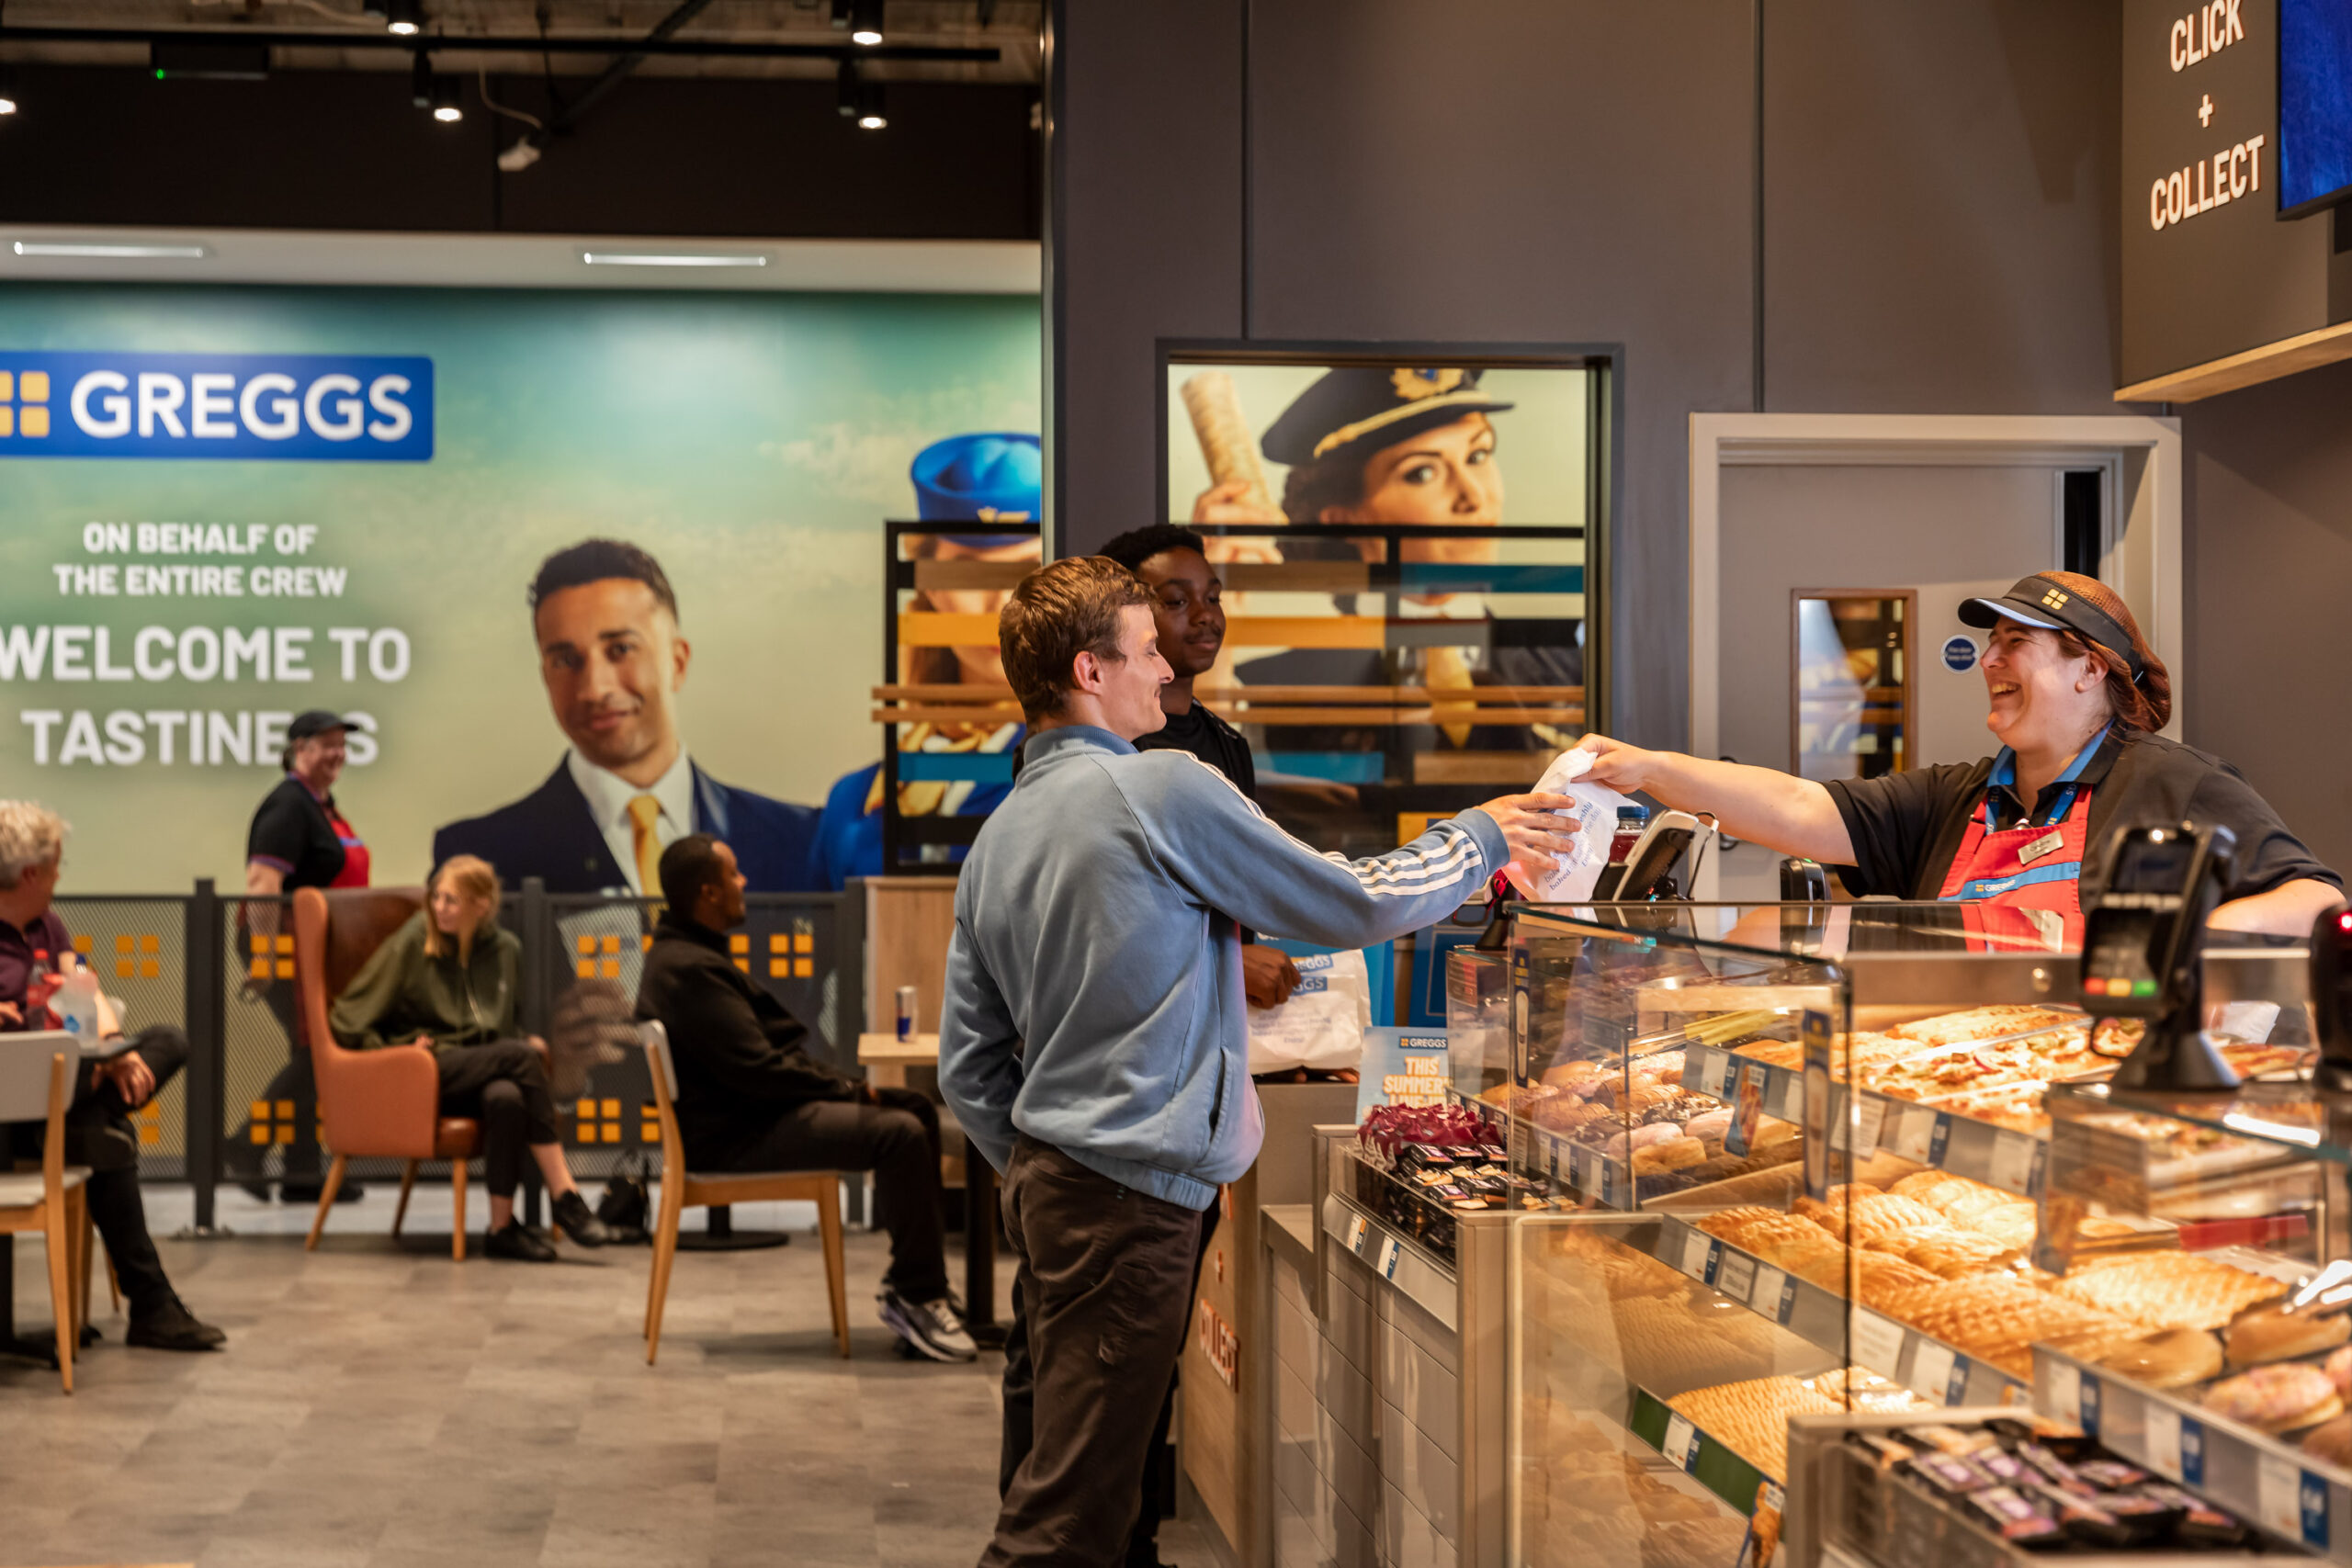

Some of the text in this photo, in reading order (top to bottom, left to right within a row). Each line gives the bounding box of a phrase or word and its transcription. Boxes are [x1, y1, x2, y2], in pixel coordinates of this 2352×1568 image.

[2170, 0, 2245, 72] CLICK
[2199, 94, 2213, 128] +
[2151, 134, 2265, 231] COLLECT
[70, 370, 413, 441] GREGGS
[84, 522, 318, 554] ON BEHALF OF
[53, 564, 347, 596] THE ENTIRE CREW
[0, 626, 411, 682] WELCOME TO
[20, 710, 379, 765] TASTINES
[1579, 801, 1594, 822] eshly
[1549, 868, 1572, 891] baked
[1409, 1038, 1447, 1048] GREGGS
[1405, 1056, 1440, 1076] THIS
